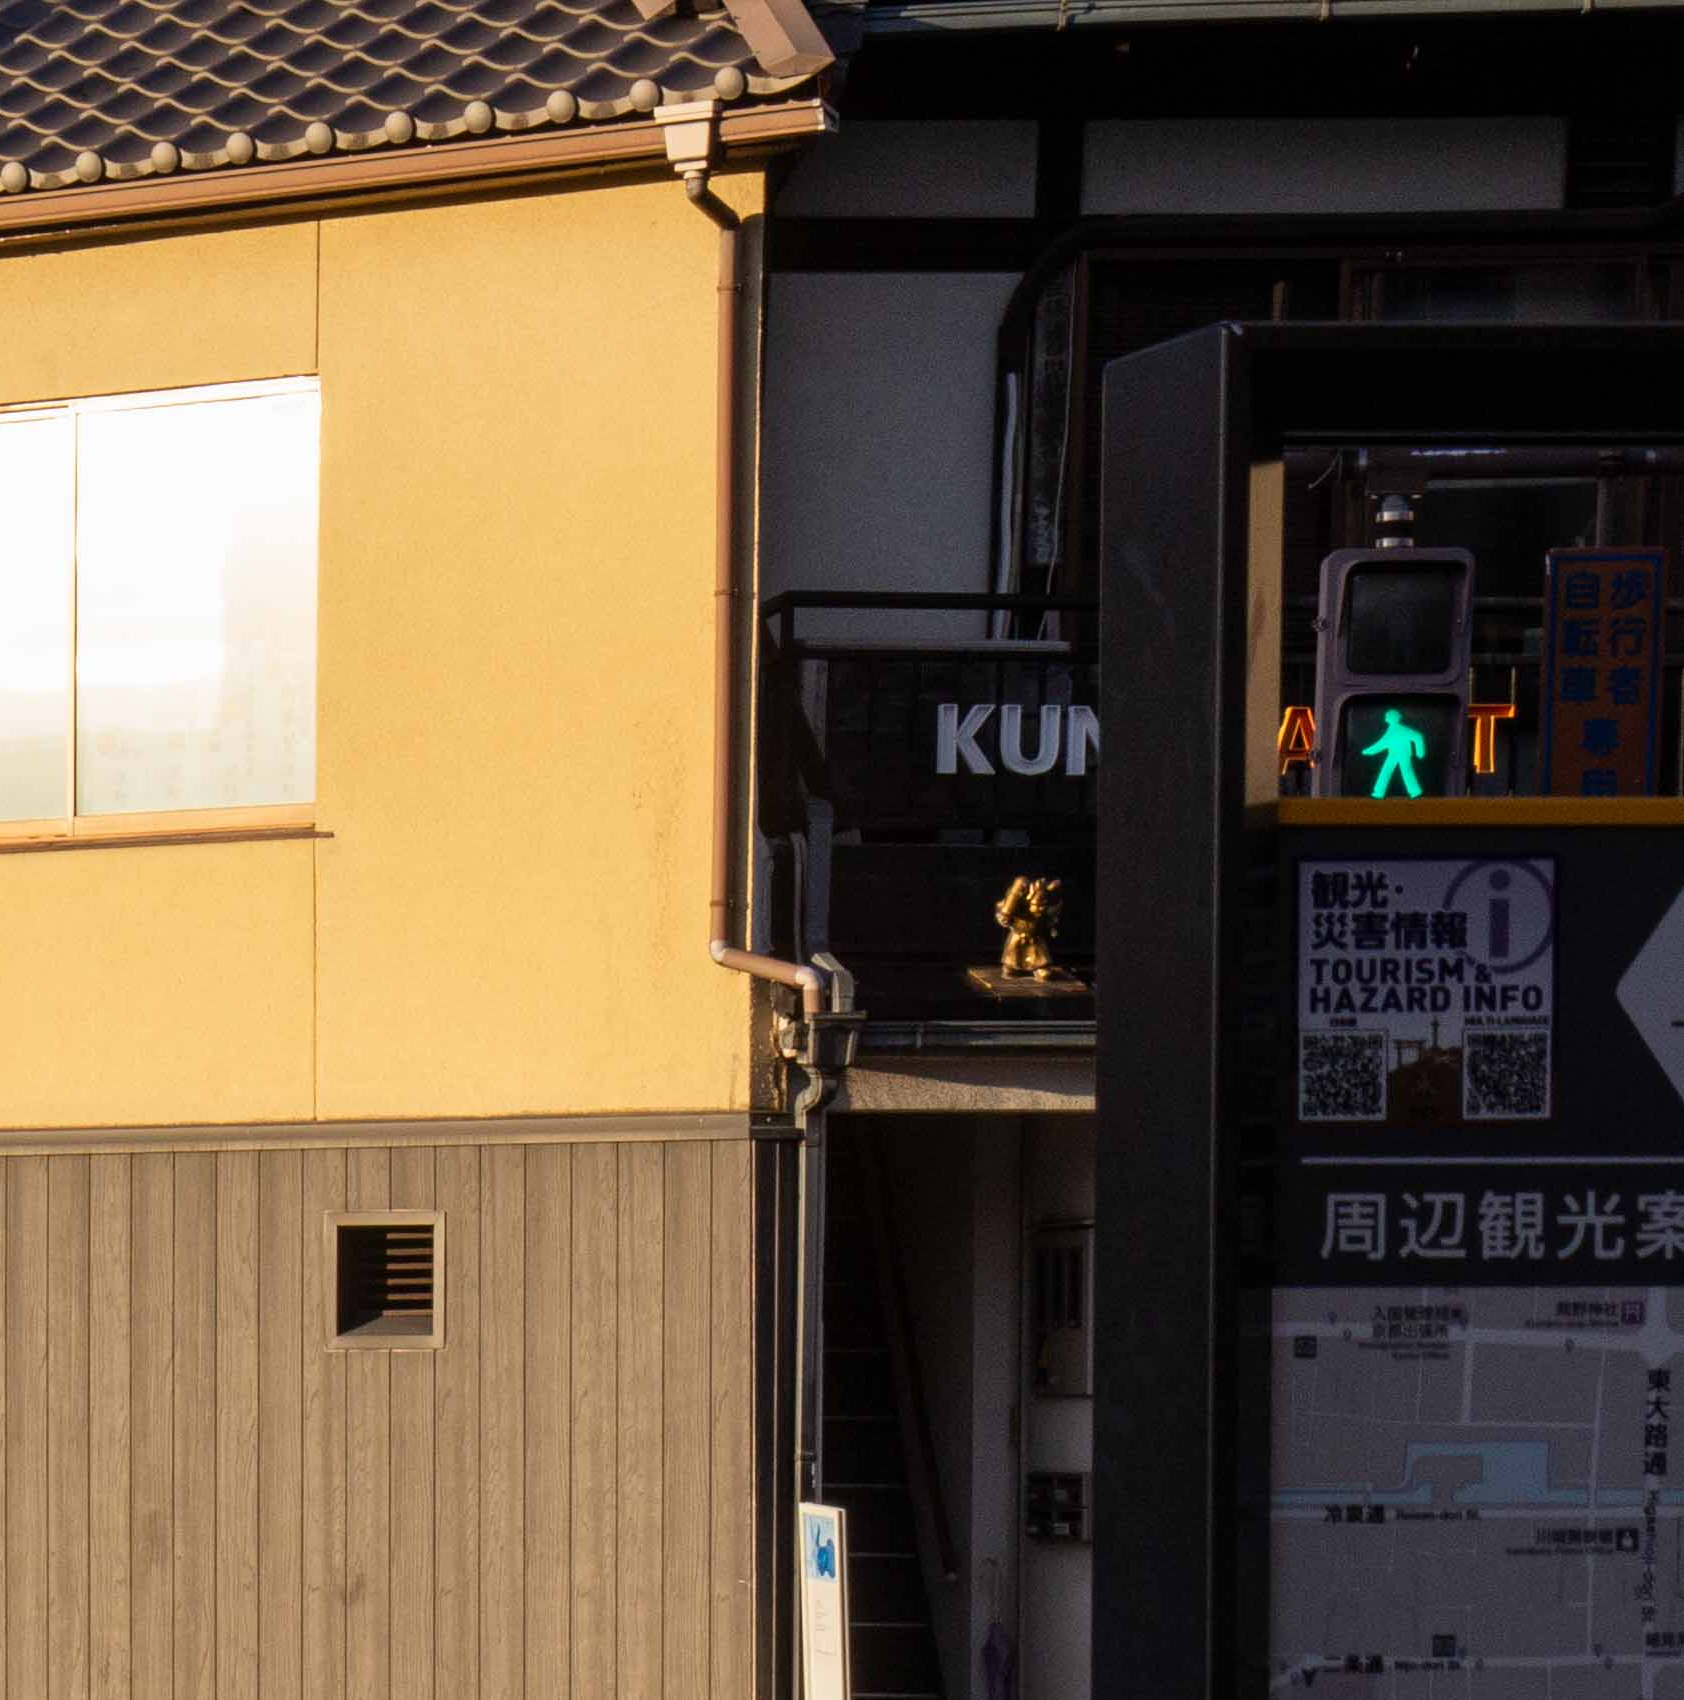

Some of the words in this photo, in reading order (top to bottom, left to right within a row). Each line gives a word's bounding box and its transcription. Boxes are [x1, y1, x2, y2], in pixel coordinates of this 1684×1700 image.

[1311, 911, 1468, 951] 災害情報
[1310, 957, 1464, 986] TOURISM
[1474, 963, 1491, 984] &
[1310, 985, 1452, 1014] HAZARD
[1463, 984, 1544, 1013] INFO
[1643, 1368, 1671, 1475] 東大路通
